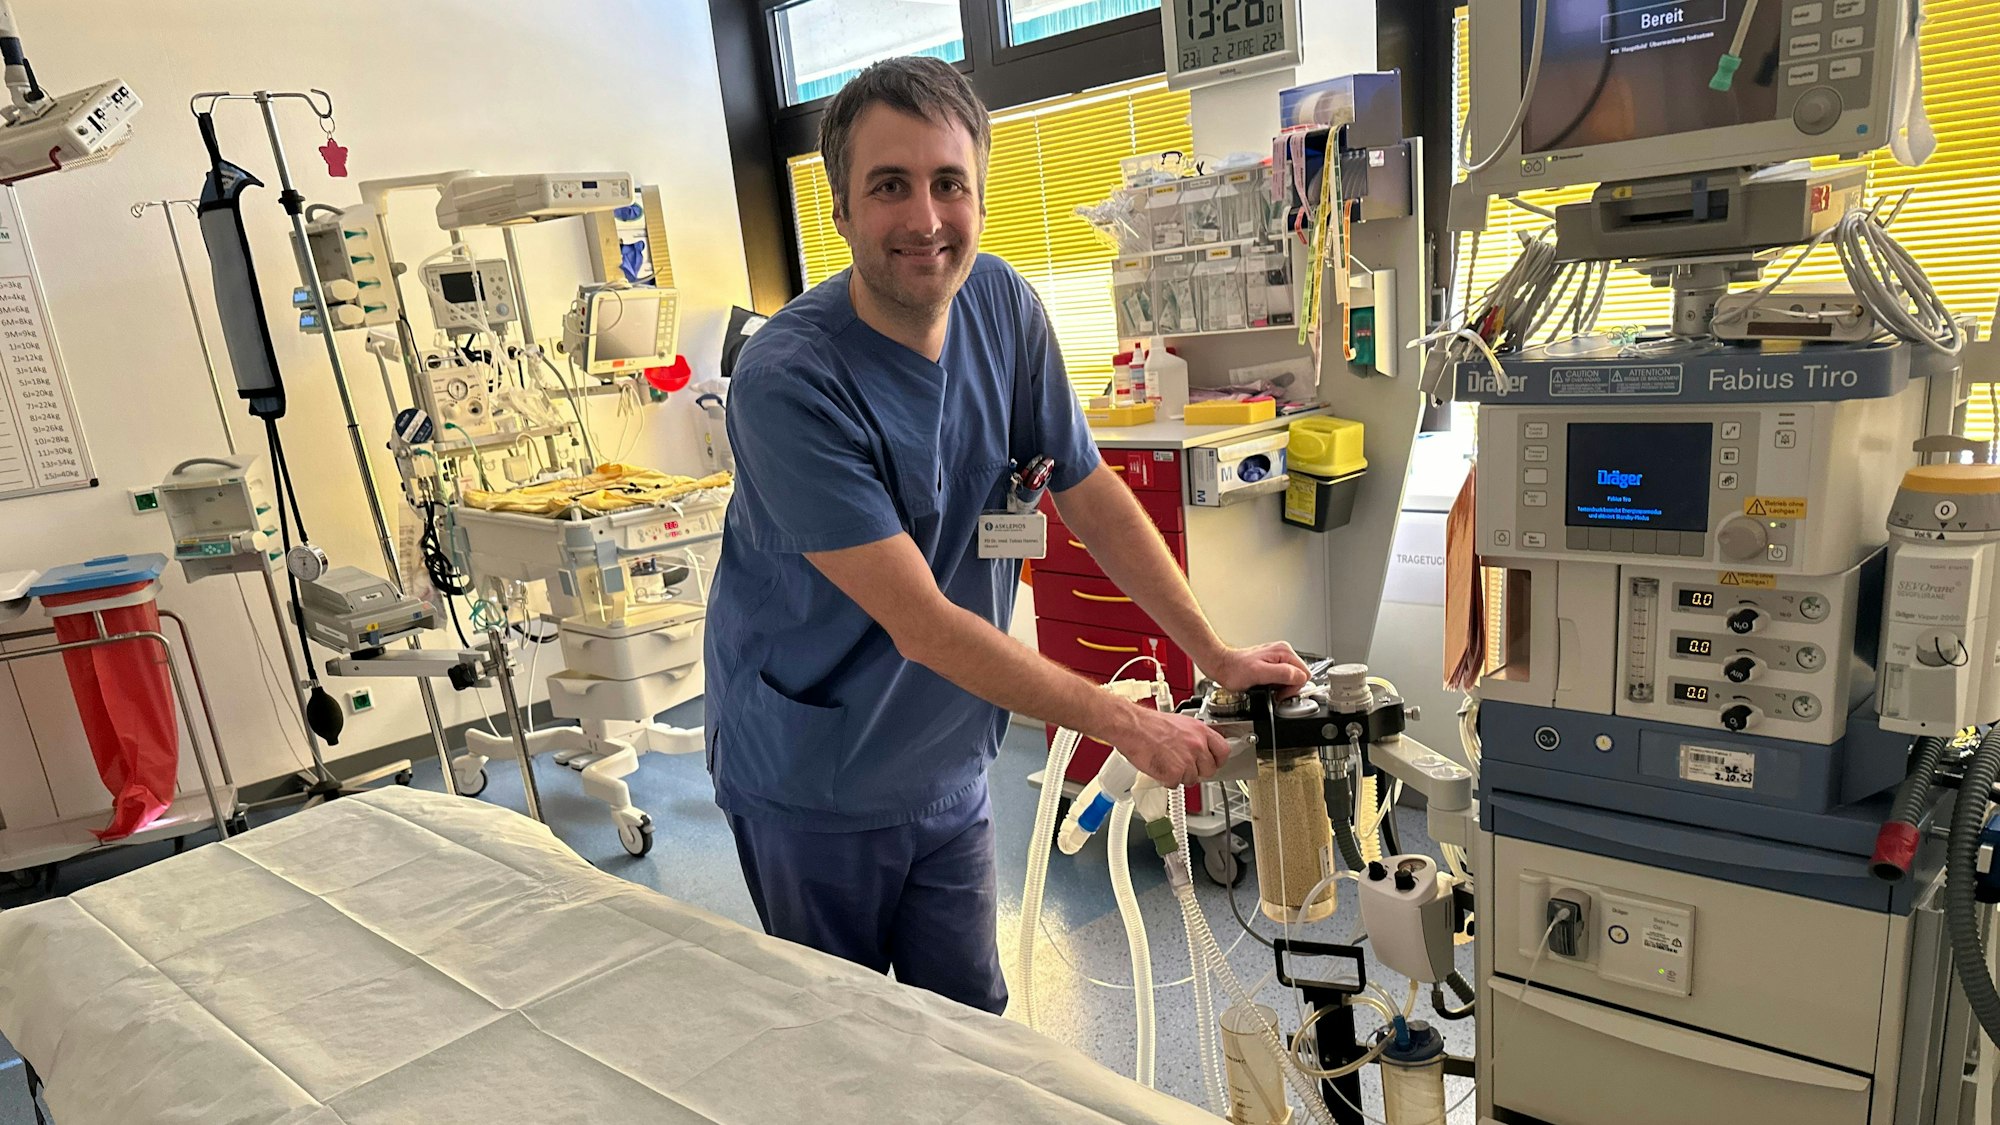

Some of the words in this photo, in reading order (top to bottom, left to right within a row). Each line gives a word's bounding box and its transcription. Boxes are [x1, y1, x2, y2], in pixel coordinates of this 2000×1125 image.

[1641, 8, 1683, 29] Bereit
[1565, 370, 1600, 378] CAUTION
[1629, 368, 1671, 377] ATTENTION
[1708, 367, 1794, 391] Fabius
[1803, 364, 1859, 388] Tiro
[22, 389, 54, 398] 6J=20kg
[26, 401, 57, 410] 7J=22kg
[1221, 467, 1232, 482] M
[1597, 469, 1643, 489] Dräger
[1197, 490, 1206, 503] M
[1898, 581, 1955, 594] SEVOrane
[1692, 592, 1713, 606] 0.0
[1689, 639, 1710, 653] 0.0
[1730, 669, 1744, 680] AIR
[1686, 686, 1707, 700] 0.0
